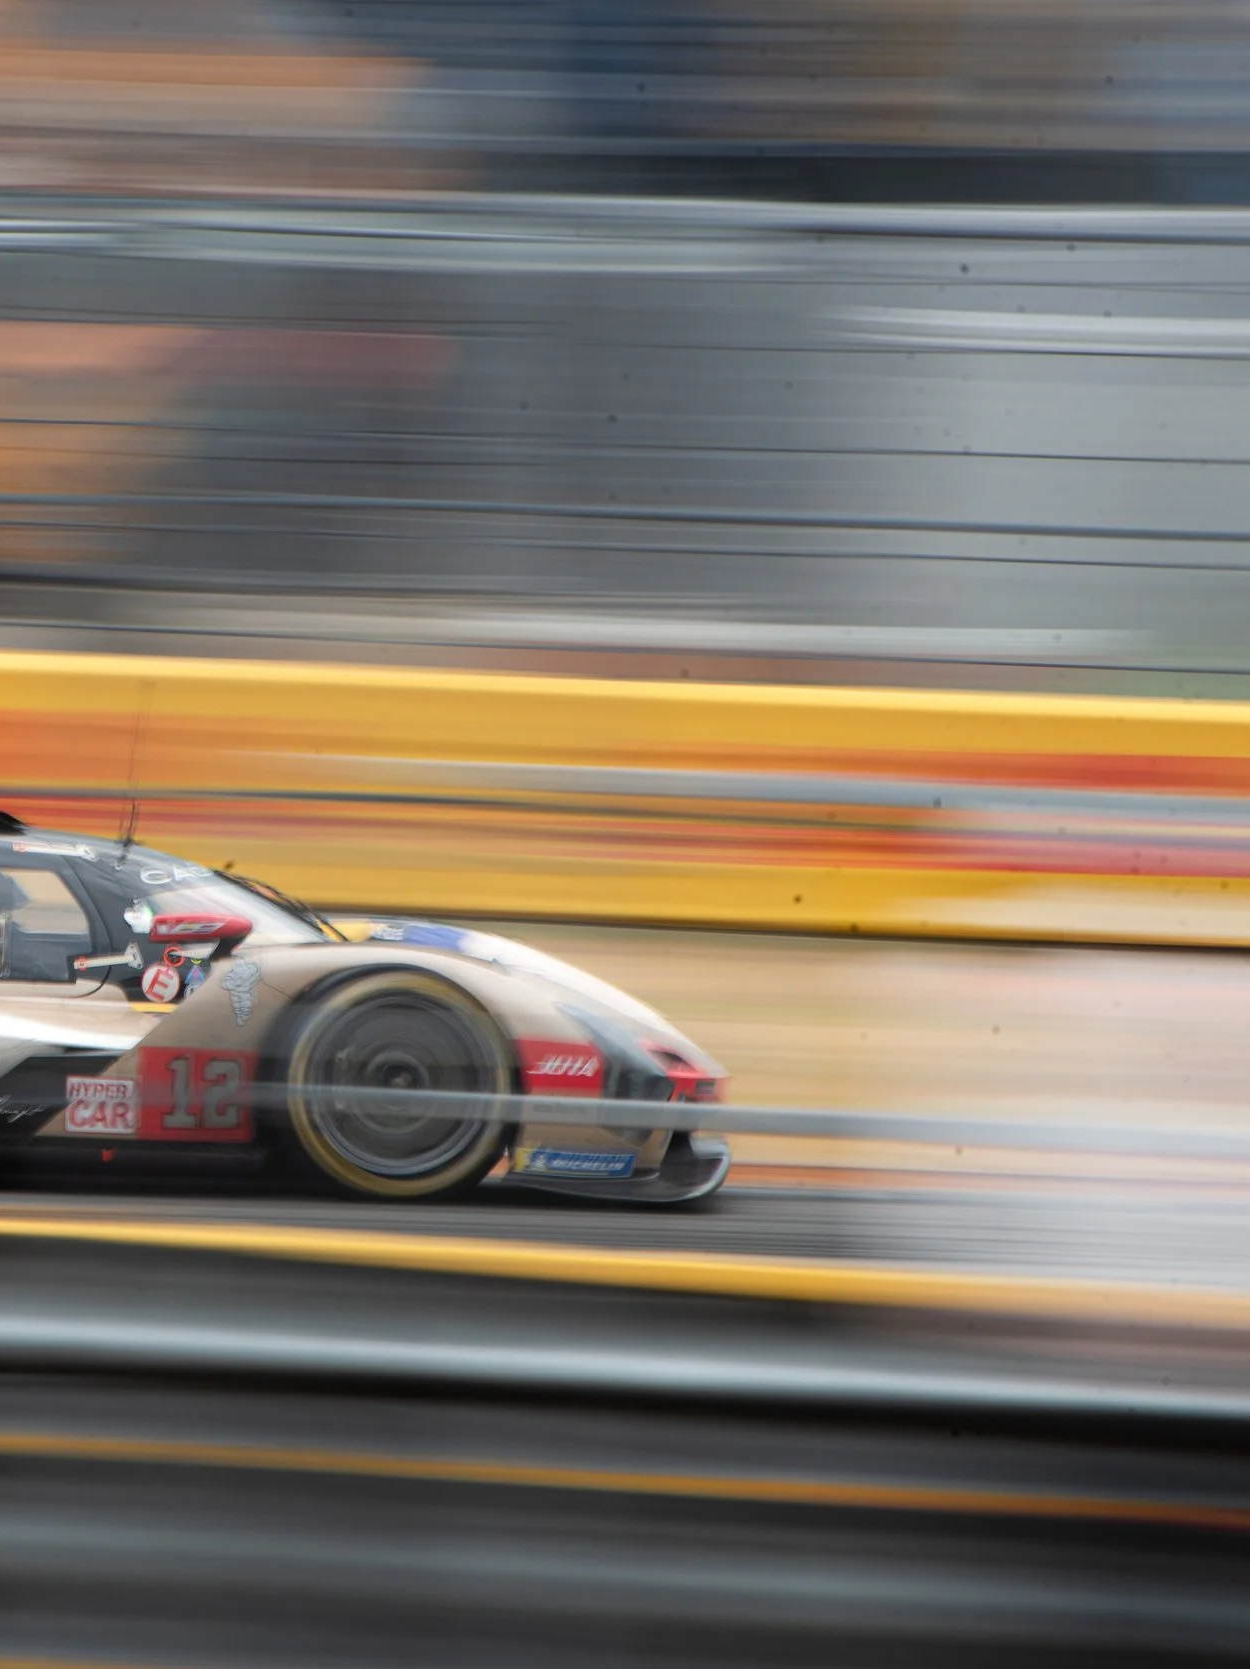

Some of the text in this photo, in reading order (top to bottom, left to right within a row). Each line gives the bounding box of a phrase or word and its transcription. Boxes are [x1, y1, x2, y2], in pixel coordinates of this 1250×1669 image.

[68, 1082, 127, 1099] HYPER
[162, 1056, 243, 1130] 12
[68, 1100, 131, 1129] CAR
[551, 1156, 626, 1171] MICHELIN
